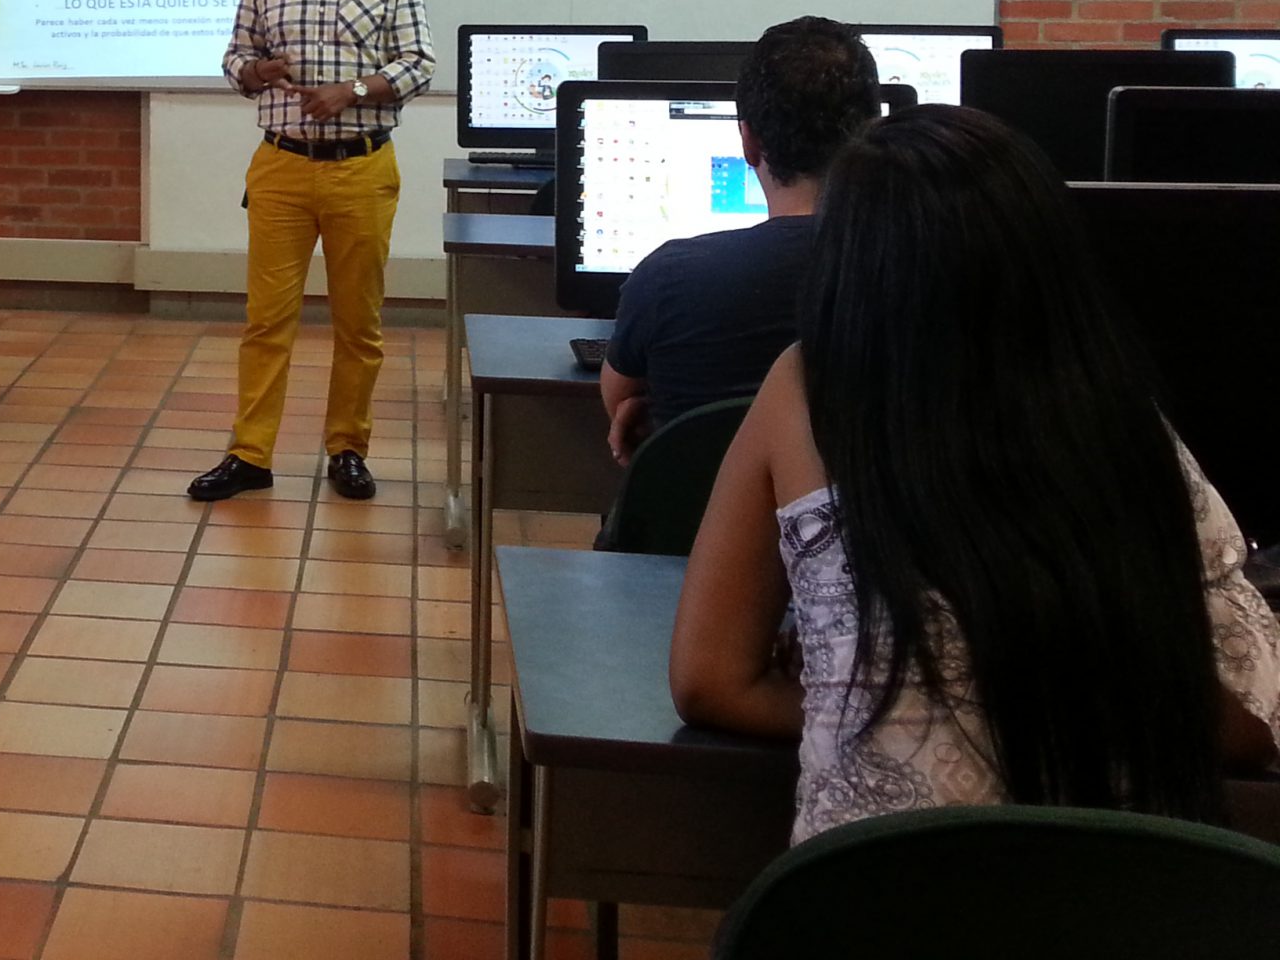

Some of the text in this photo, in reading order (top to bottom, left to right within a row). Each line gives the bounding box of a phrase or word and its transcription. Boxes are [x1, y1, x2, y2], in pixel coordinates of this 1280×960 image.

[68, 17, 93, 26] haber
[97, 17, 118, 26] cada
[139, 17, 168, 25] menos
[51, 30, 81, 39] activos
[101, 28, 157, 39] probabilidad
[159, 28, 169, 37] de
[171, 30, 189, 39] que
